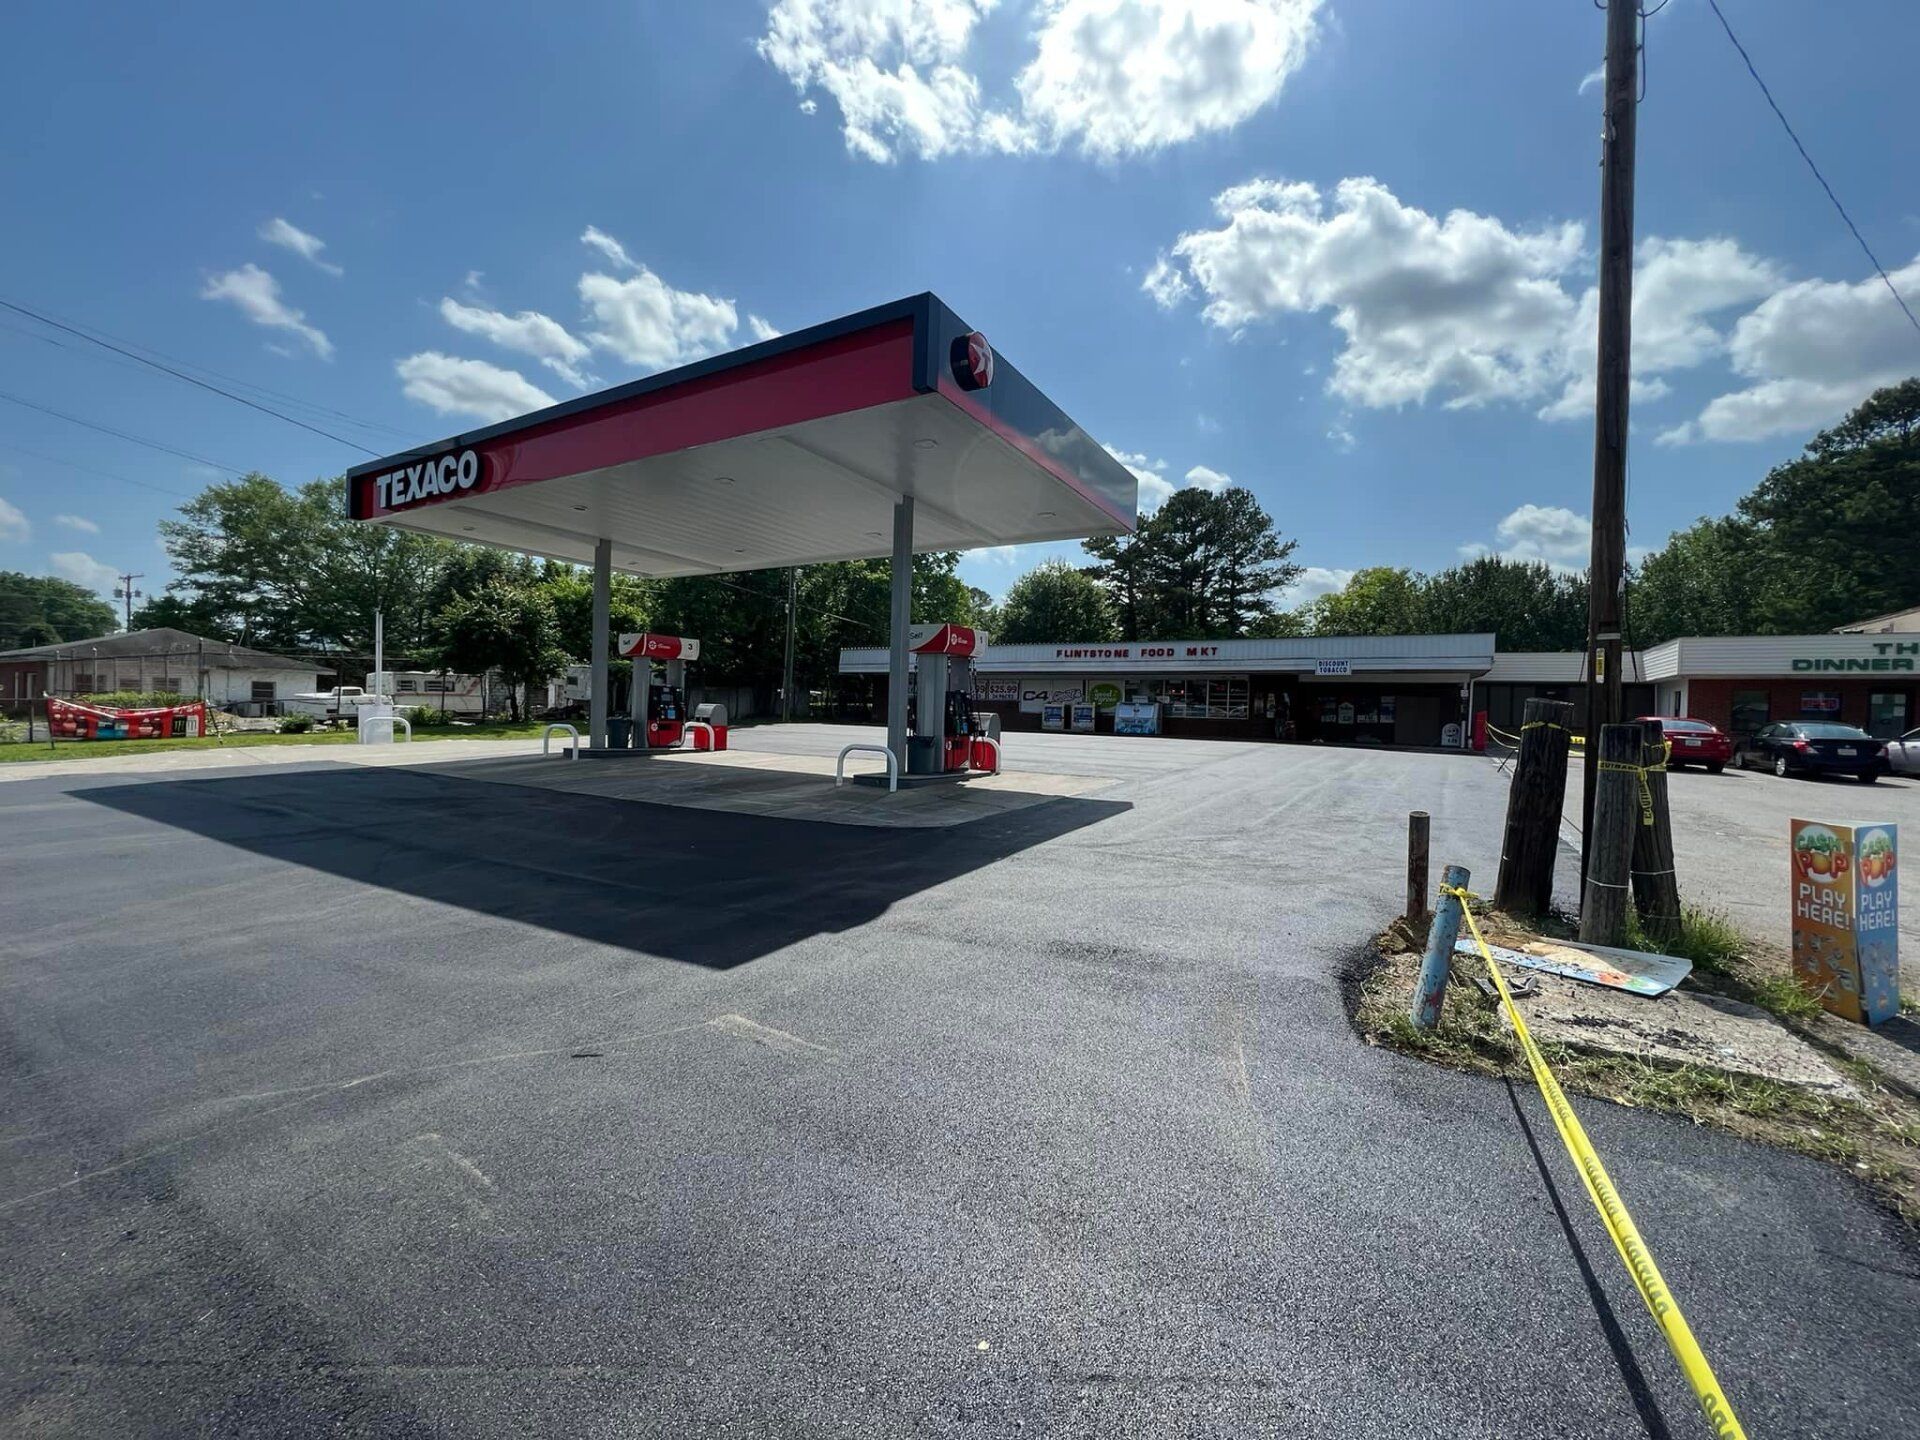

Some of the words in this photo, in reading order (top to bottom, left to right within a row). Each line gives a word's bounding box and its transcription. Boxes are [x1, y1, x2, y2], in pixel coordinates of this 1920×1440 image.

[376, 449, 478, 508] TEXACO
[687, 643, 694, 651] 3
[1056, 648, 1130, 658] FLINTSTONE
[1141, 648, 1175, 657] FOOD
[1186, 646, 1219, 657] MKT
[1318, 659, 1349, 667] DISCOUNT
[1319, 666, 1348, 674] TOBACCO
[1791, 658, 1915, 671] DINNER
[1022, 690, 1049, 701] C4
[1795, 833, 1845, 853] CASH
[1794, 849, 1849, 878] POP
[1859, 848, 1896, 886] POP
[1799, 882, 1846, 909] PLAY
[1860, 890, 1893, 913] PLAY
[1797, 899, 1850, 931] HERE!
[1860, 909, 1896, 932] HERE!
